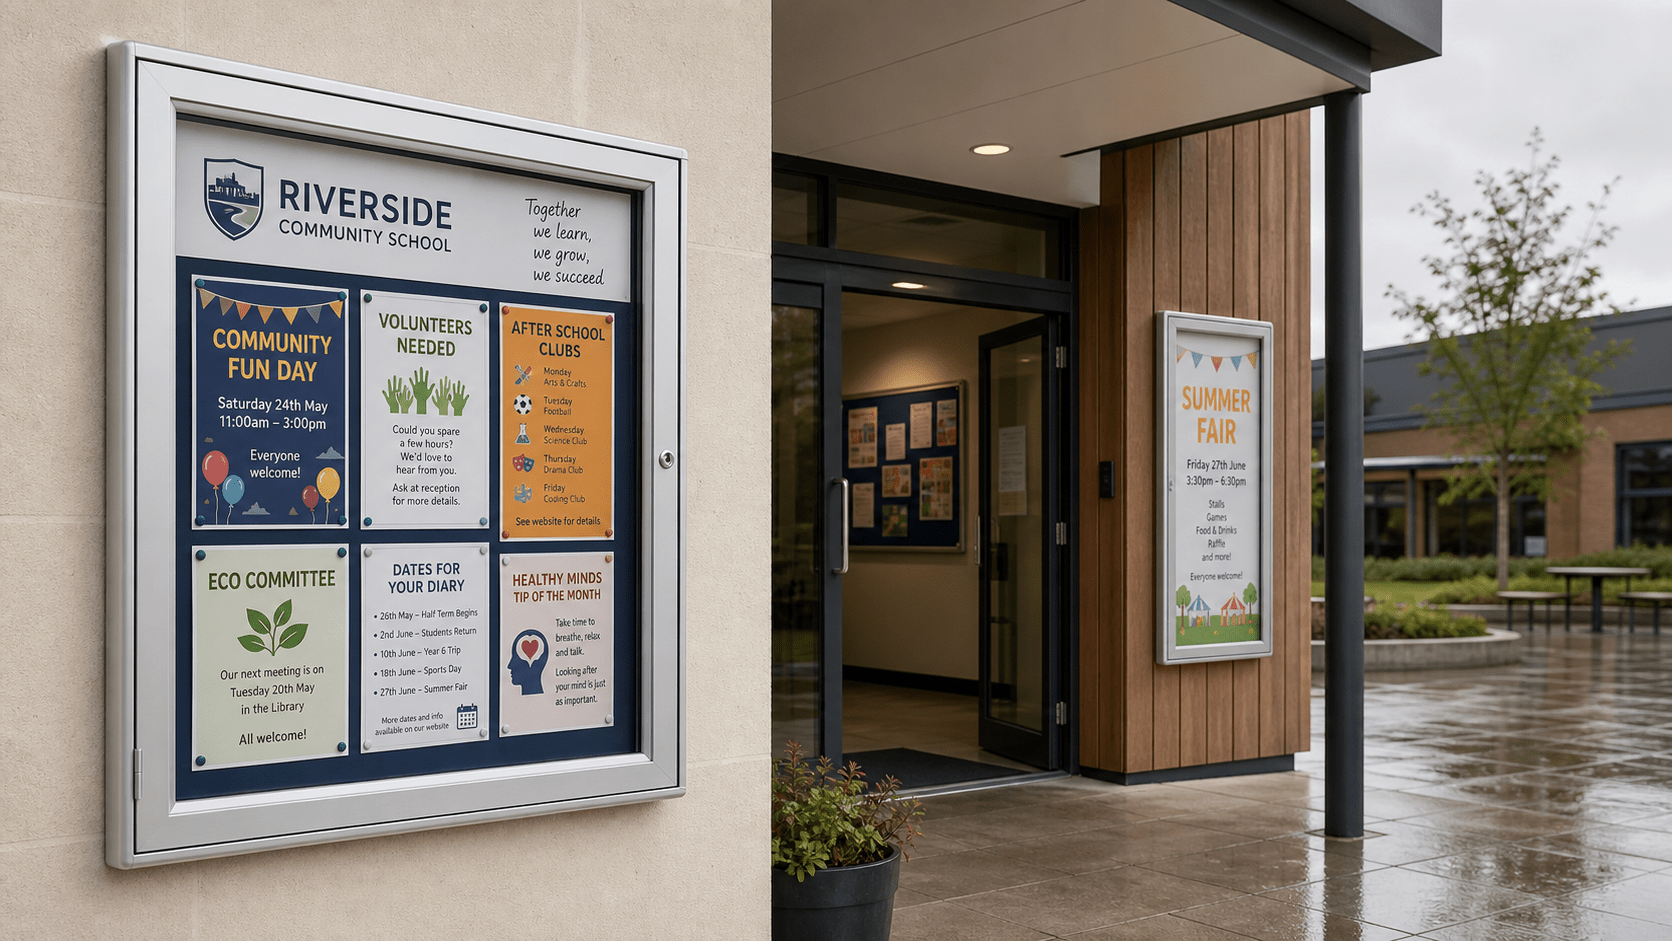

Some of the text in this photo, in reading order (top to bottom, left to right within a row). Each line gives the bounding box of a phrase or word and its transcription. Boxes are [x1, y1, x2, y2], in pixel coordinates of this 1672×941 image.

[279, 179, 452, 230] RIVERSIDE
[525, 198, 581, 220] Together
[279, 219, 452, 253] COMMUNITY SCHOOL
[533, 225, 592, 242] we learn,
[533, 247, 590, 266] we grow,
[533, 269, 604, 285] we succeed
[379, 313, 472, 335] VOLUNTEERS
[512, 321, 605, 341] AFTER SCHOOL
[213, 329, 332, 354] COMMUNITY
[398, 337, 455, 356] NEEDED
[539, 342, 580, 357] CLUBS
[228, 358, 317, 381] FUN DAY
[544, 367, 571, 377] Monday
[544, 396, 572, 406] Tuesday
[1182, 385, 1251, 413] SUMMER
[218, 397, 328, 414] Saturday 24th May
[219, 416, 269, 428] 11:00am
[283, 417, 326, 432] 3:00pm
[393, 425, 460, 437] Could you spare
[544, 426, 584, 435] Wednesday
[1197, 417, 1236, 444] FAIR
[407, 439, 423, 448] few
[426, 440, 453, 448] hours?
[251, 449, 300, 464] Everyone
[400, 452, 422, 461] We'd
[425, 453, 441, 461] love
[544, 455, 576, 464] Thursday
[250, 466, 300, 478] welcome!
[397, 466, 456, 477] hear from you.
[544, 466, 583, 474] Drama Club
[1187, 459, 1246, 473] Friday 27th June
[1186, 475, 1212, 488] 3:30pm
[1221, 476, 1246, 488] 6:30pm
[393, 484, 408, 492] Ask
[422, 484, 460, 494] reception
[544, 484, 566, 493] Friday
[392, 497, 405, 505] for
[431, 497, 460, 505] details.
[544, 495, 585, 504] Coding Club
[1209, 499, 1225, 508] Stalls
[516, 517, 600, 526] See website for details
[1207, 513, 1227, 522] Games
[1196, 525, 1237, 535] Food & Drinks
[1202, 552, 1231, 561] and more!
[393, 563, 460, 575] DATES FOR
[209, 570, 335, 590] ECO COMMITTEE
[513, 572, 602, 586] HEALTHY MINDS
[1190, 571, 1243, 582] Everyone welcome!
[389, 580, 464, 593] YOUR DIARY
[514, 589, 601, 603] TIP OF THE MONTH
[380, 612, 396, 620] 26th
[399, 611, 413, 621] May
[422, 610, 435, 618] Half
[437, 610, 454, 618] Term
[456, 609, 478, 618] Begins
[556, 618, 571, 627] Take
[573, 618, 587, 626] time
[380, 631, 394, 639] 2nd
[397, 630, 413, 638] June
[422, 628, 452, 637] Students
[556, 632, 600, 642] breathe, relax
[381, 650, 396, 658] 10th
[398, 649, 415, 657] June
[424, 648, 439, 656] Year
[448, 646, 461, 655] Trip
[556, 647, 584, 657] and talk.
[220, 665, 324, 680] Our next meeting is on
[381, 669, 396, 677] 18th
[398, 668, 416, 677] June
[424, 666, 446, 676] Sports
[449, 665, 462, 674] Day
[556, 665, 597, 677] Looking after
[231, 683, 315, 698] Tuesday 20th May
[380, 687, 396, 696] 27th
[398, 687, 416, 695] June
[424, 685, 453, 694] Summer
[555, 683, 570, 693] your
[572, 681, 586, 689] mind
[555, 694, 597, 706] as important.
[241, 702, 304, 714] in the Library
[382, 716, 398, 724] More
[375, 727, 403, 736] available
[426, 723, 449, 731] website
[239, 729, 307, 745] All welcome!
